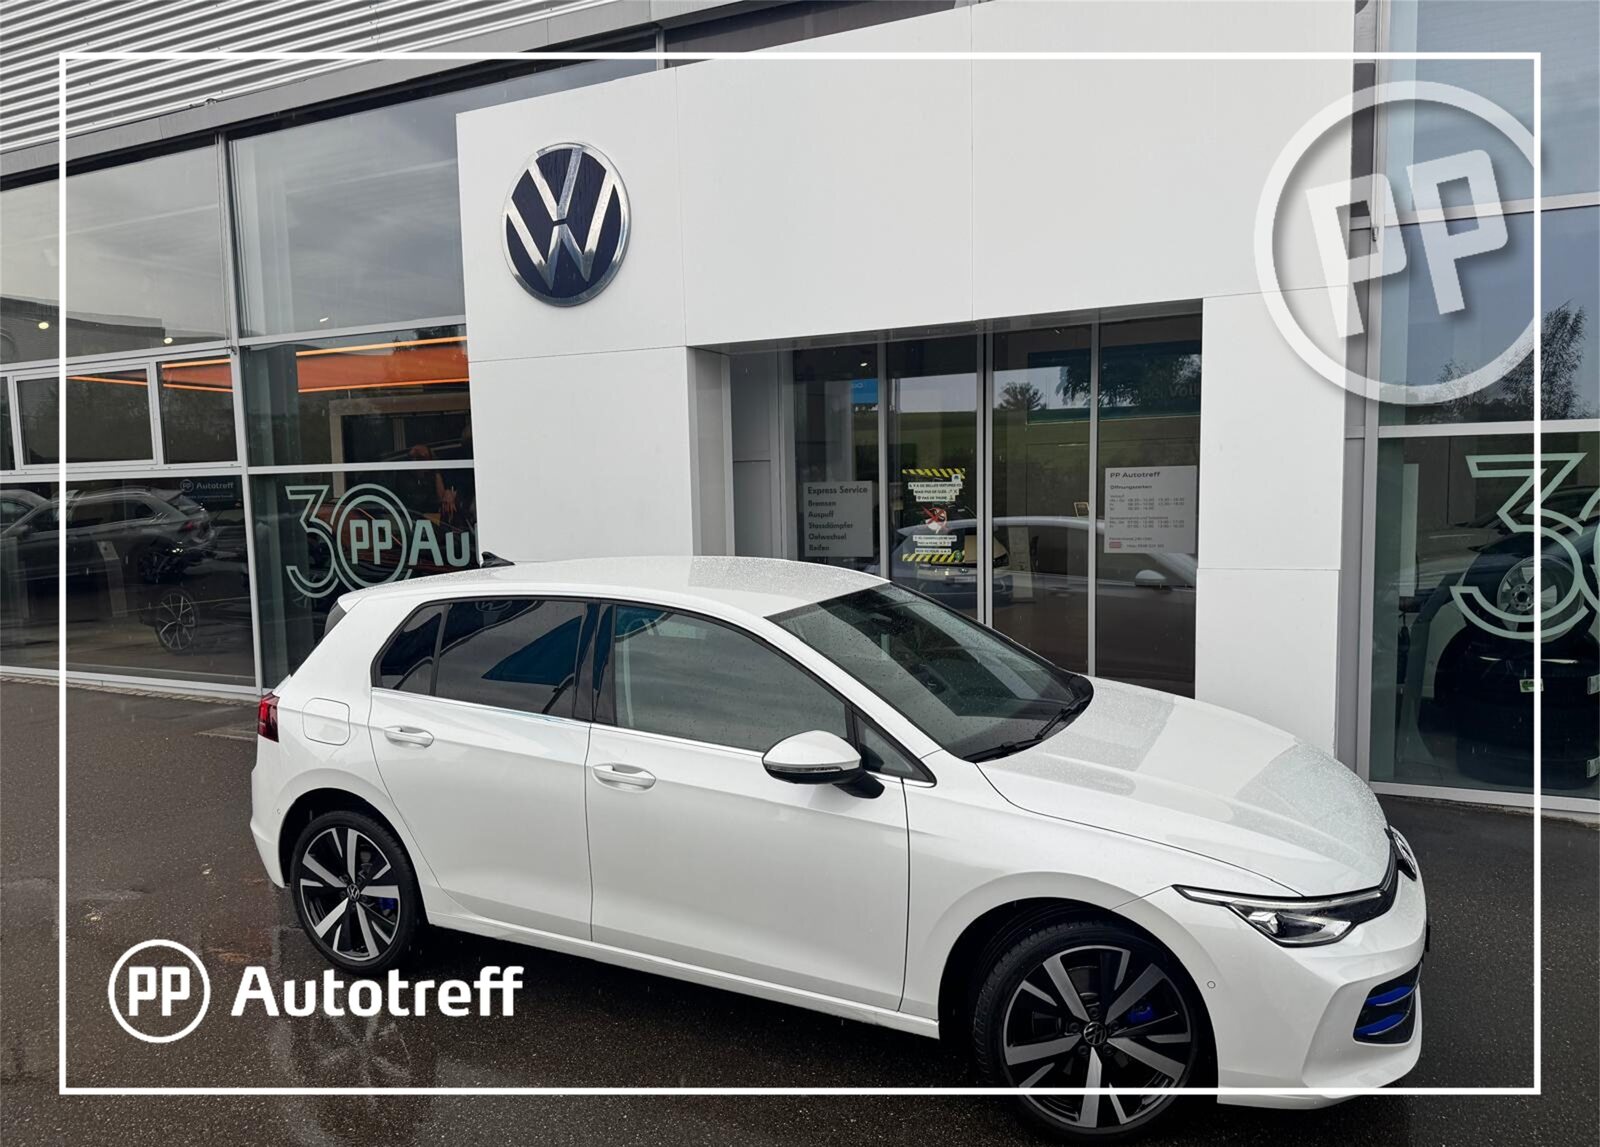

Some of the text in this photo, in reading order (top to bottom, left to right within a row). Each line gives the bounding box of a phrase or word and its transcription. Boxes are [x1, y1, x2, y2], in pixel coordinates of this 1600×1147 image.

[1122, 471, 1161, 479] Autotreff
[807, 484, 868, 496] Express Service
[807, 510, 835, 519] Auspuff
[349, 519, 393, 565] PP
